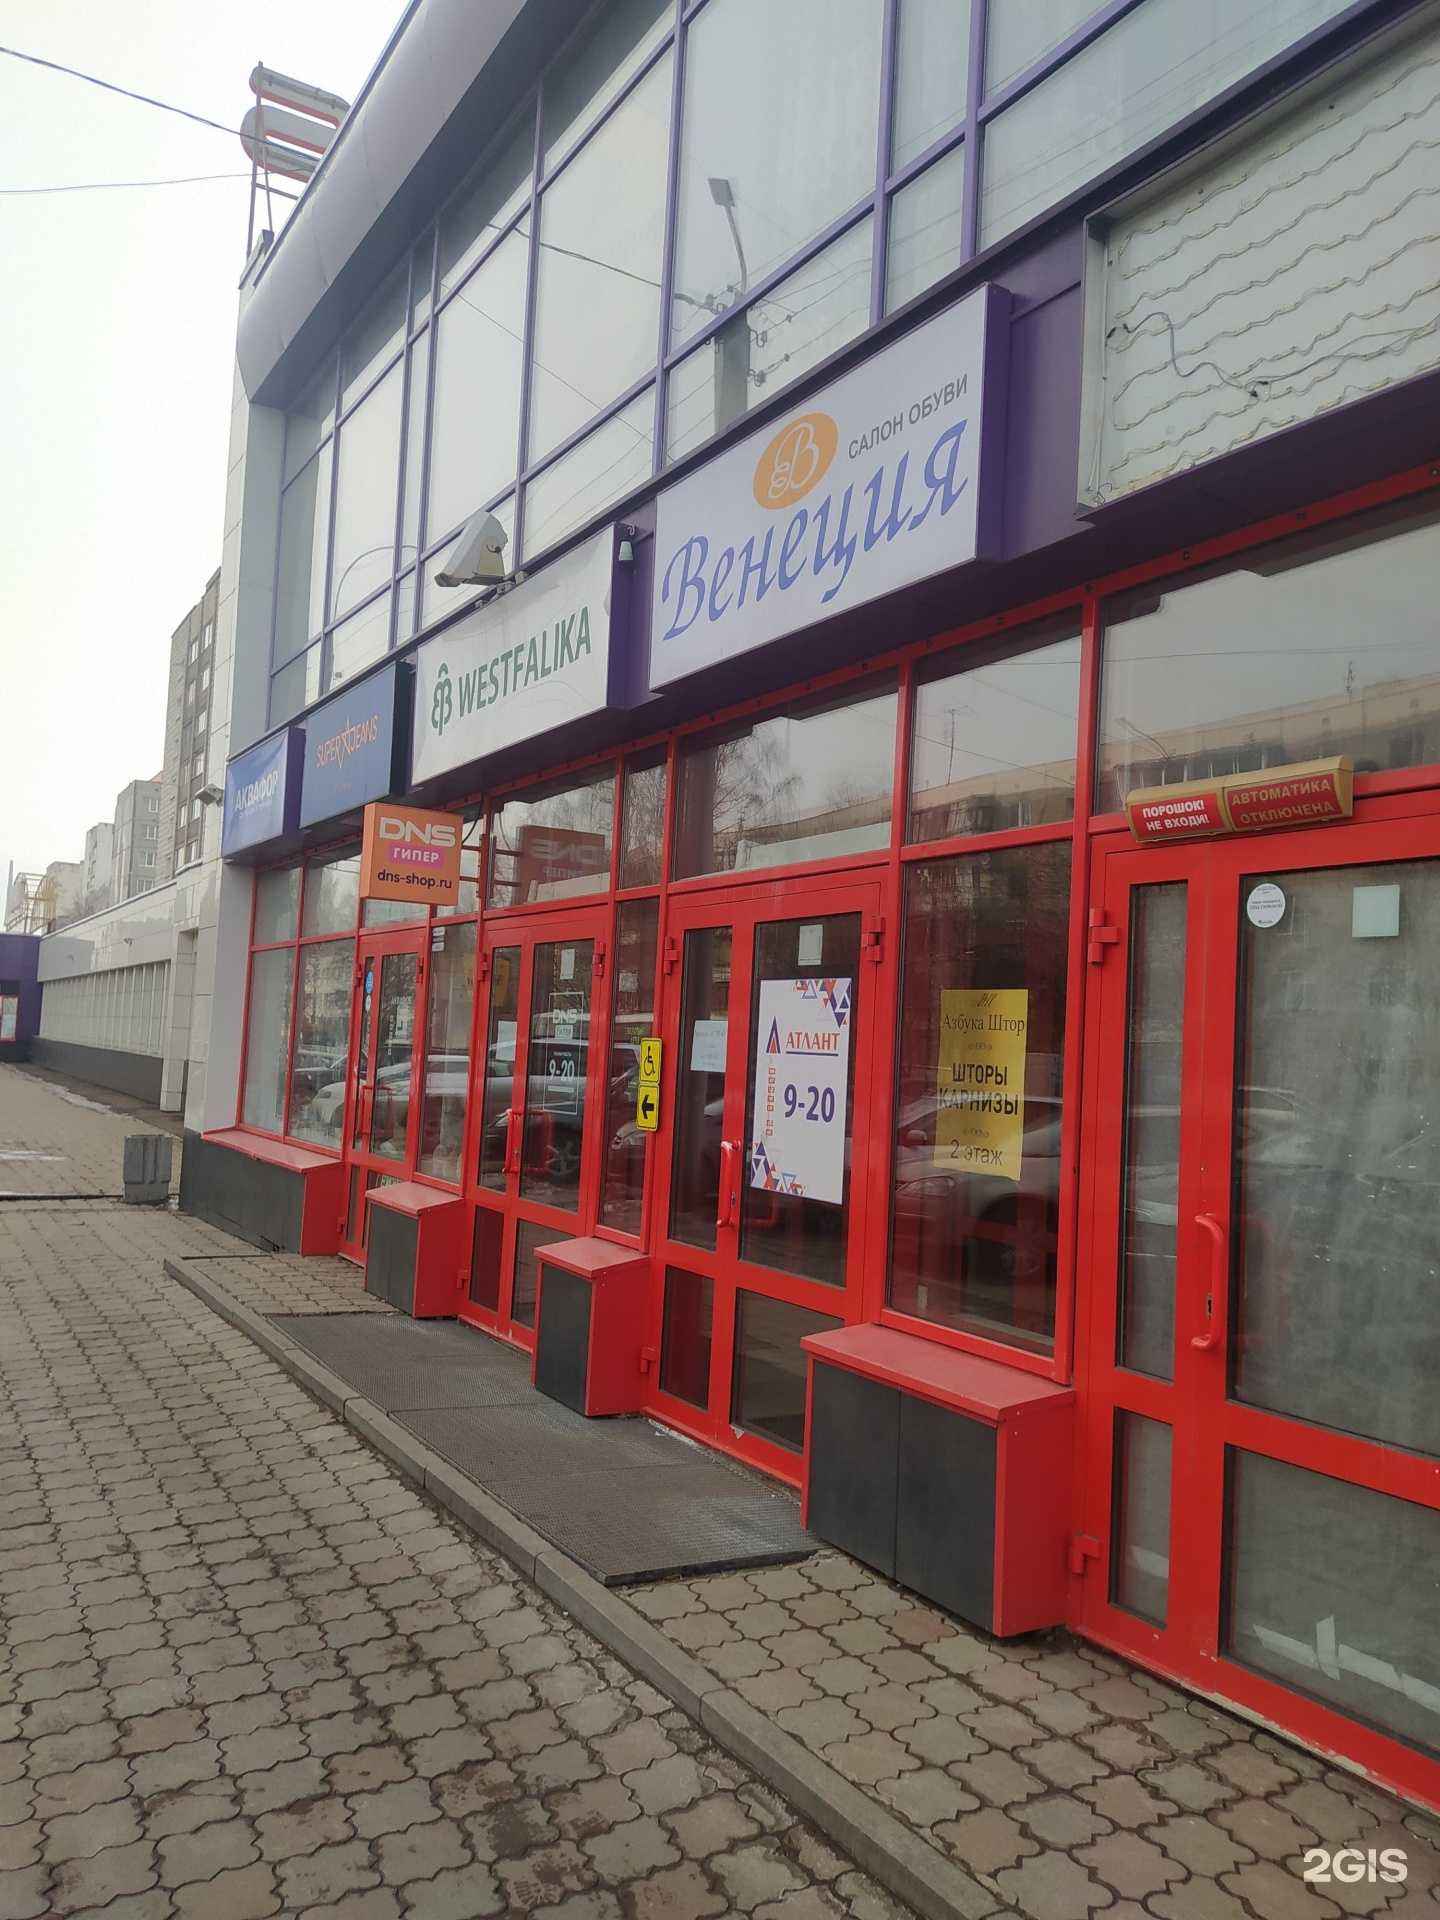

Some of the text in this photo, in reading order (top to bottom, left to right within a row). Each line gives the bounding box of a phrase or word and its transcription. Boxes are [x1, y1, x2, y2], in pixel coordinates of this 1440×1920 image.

[847, 374, 968, 460] САЛОН ОБУВИ
[661, 419, 968, 641] Венеция
[458, 605, 591, 718] WESTFALIKA
[1230, 778, 1332, 808] АВТОМАТИКА
[1142, 799, 1206, 819] ПОРОШОК!
[1239, 801, 1336, 825] ОТКЛЮЧЕНА
[379, 816, 456, 848] DNS
[1146, 813, 1210, 831] НЕ ВХОДИ!
[393, 847, 440, 863] ГИПЕР
[377, 869, 453, 889] dns-shop.ru
[943, 1013, 1025, 1037] Азбука Штор
[786, 1031, 841, 1052] АТЛАНТ
[549, 1059, 575, 1081] 9-20
[952, 1062, 1009, 1086] ШТОРЫ
[784, 1083, 836, 1123] 9-20
[940, 1087, 1019, 1116] КАРНИЗЫ
[950, 1139, 1003, 1166] 2 этаж
